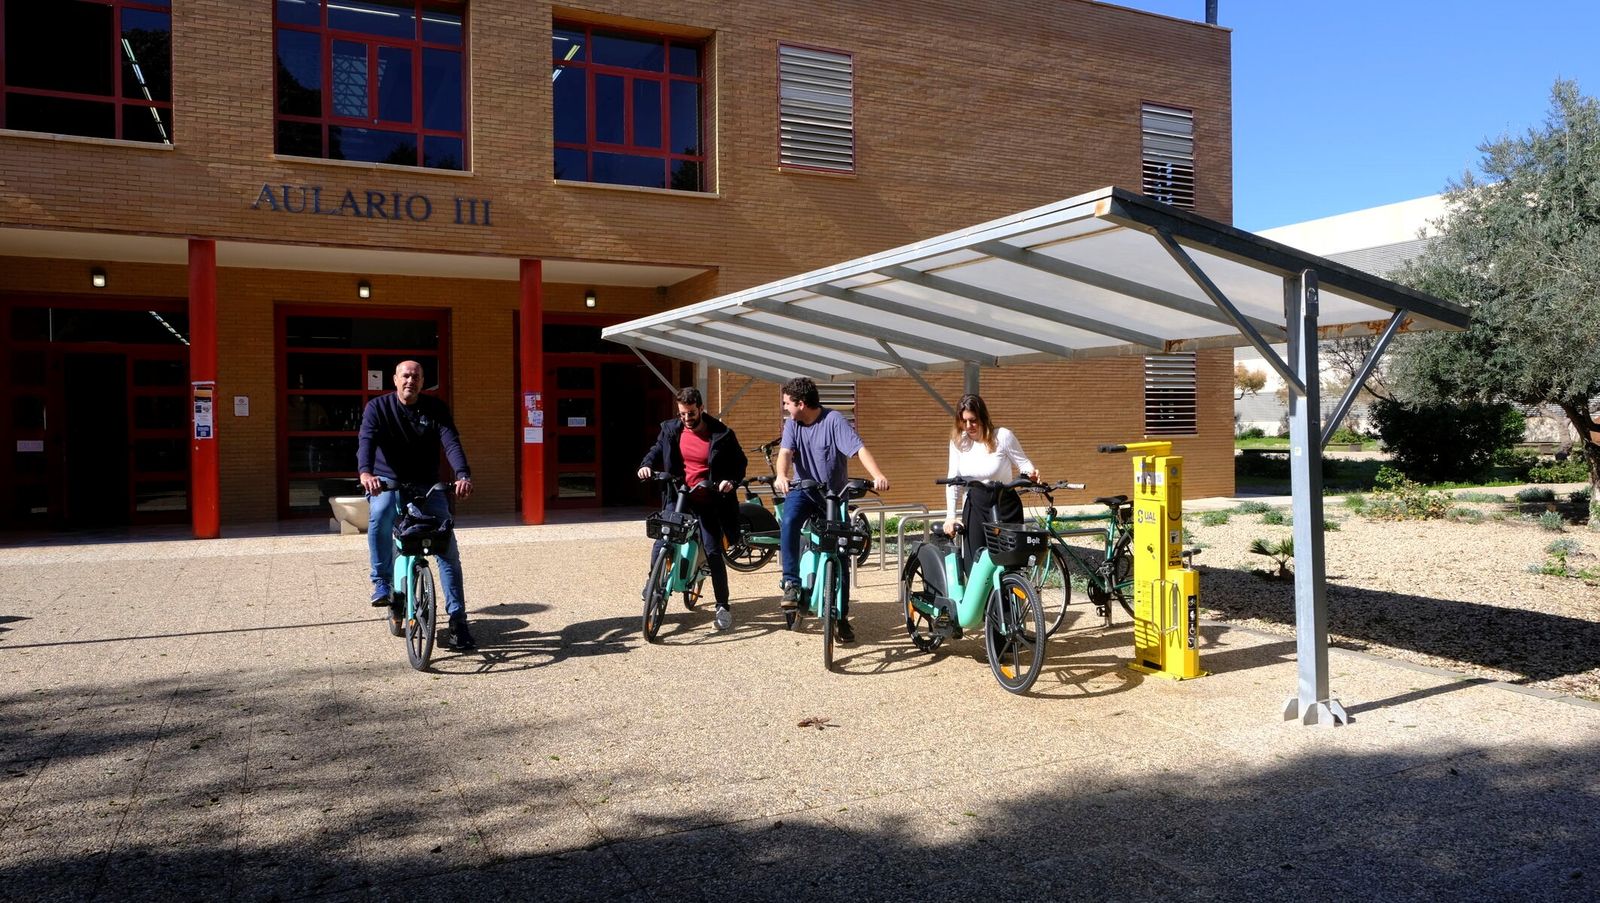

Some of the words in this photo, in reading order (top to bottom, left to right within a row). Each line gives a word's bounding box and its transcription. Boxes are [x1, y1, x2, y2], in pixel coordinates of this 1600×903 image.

[252, 183, 433, 222] AULARIO
[454, 197, 493, 226] III
[1026, 536, 1040, 544] Bolt
